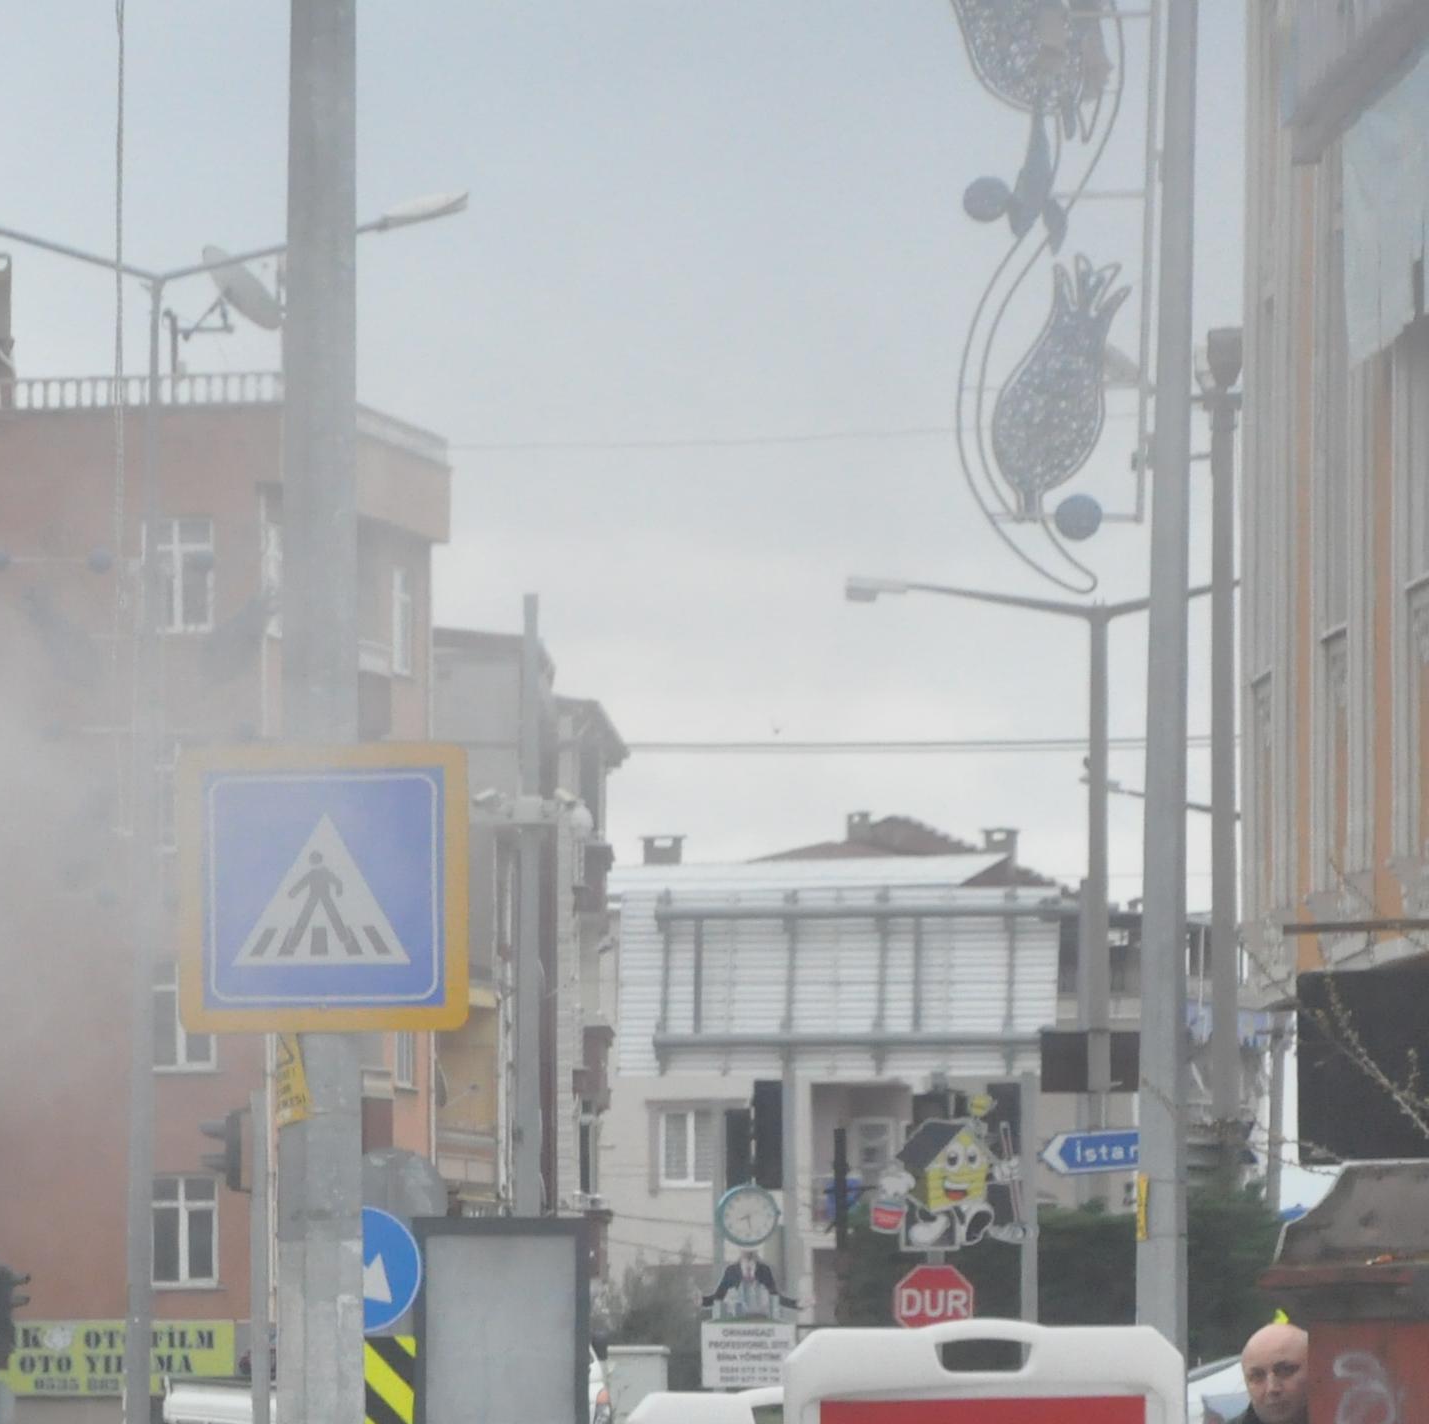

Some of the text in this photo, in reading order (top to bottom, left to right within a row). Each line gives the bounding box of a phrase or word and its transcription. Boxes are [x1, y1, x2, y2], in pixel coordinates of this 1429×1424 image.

[900, 1288, 968, 1317] DUR
[84, 1330, 126, 1349] OT
[19, 1355, 72, 1374] OTO
